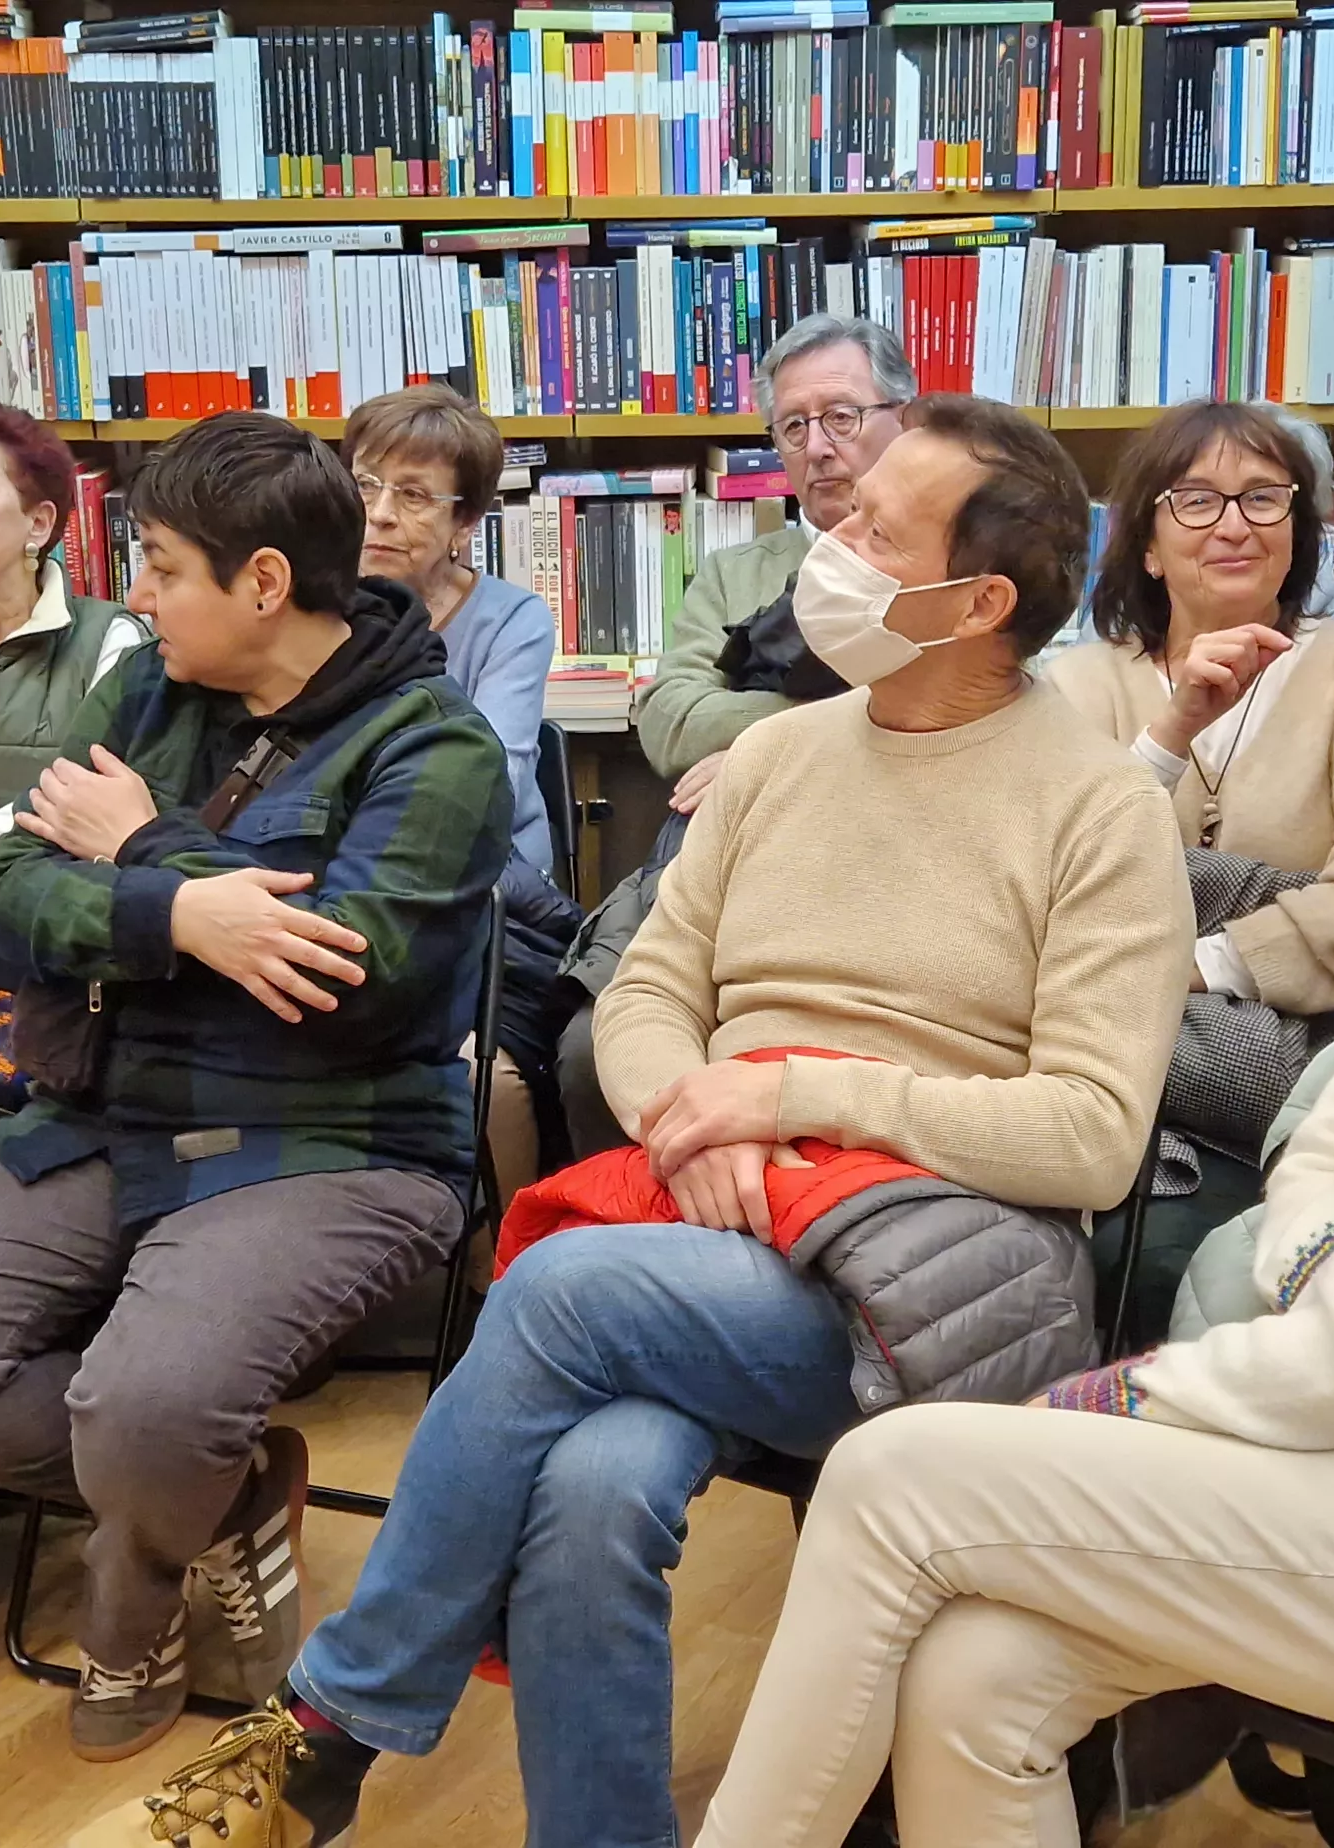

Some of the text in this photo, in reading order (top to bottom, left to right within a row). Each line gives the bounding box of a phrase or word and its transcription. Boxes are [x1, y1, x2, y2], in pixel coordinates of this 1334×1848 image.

[240, 234, 333, 246] JAVIER CASTILLO
[533, 511, 543, 522] EL
[546, 511, 557, 522] EL
[532, 525, 543, 558] JUICIO
[547, 525, 558, 559] JUICIO
[548, 575, 559, 594] ROB
